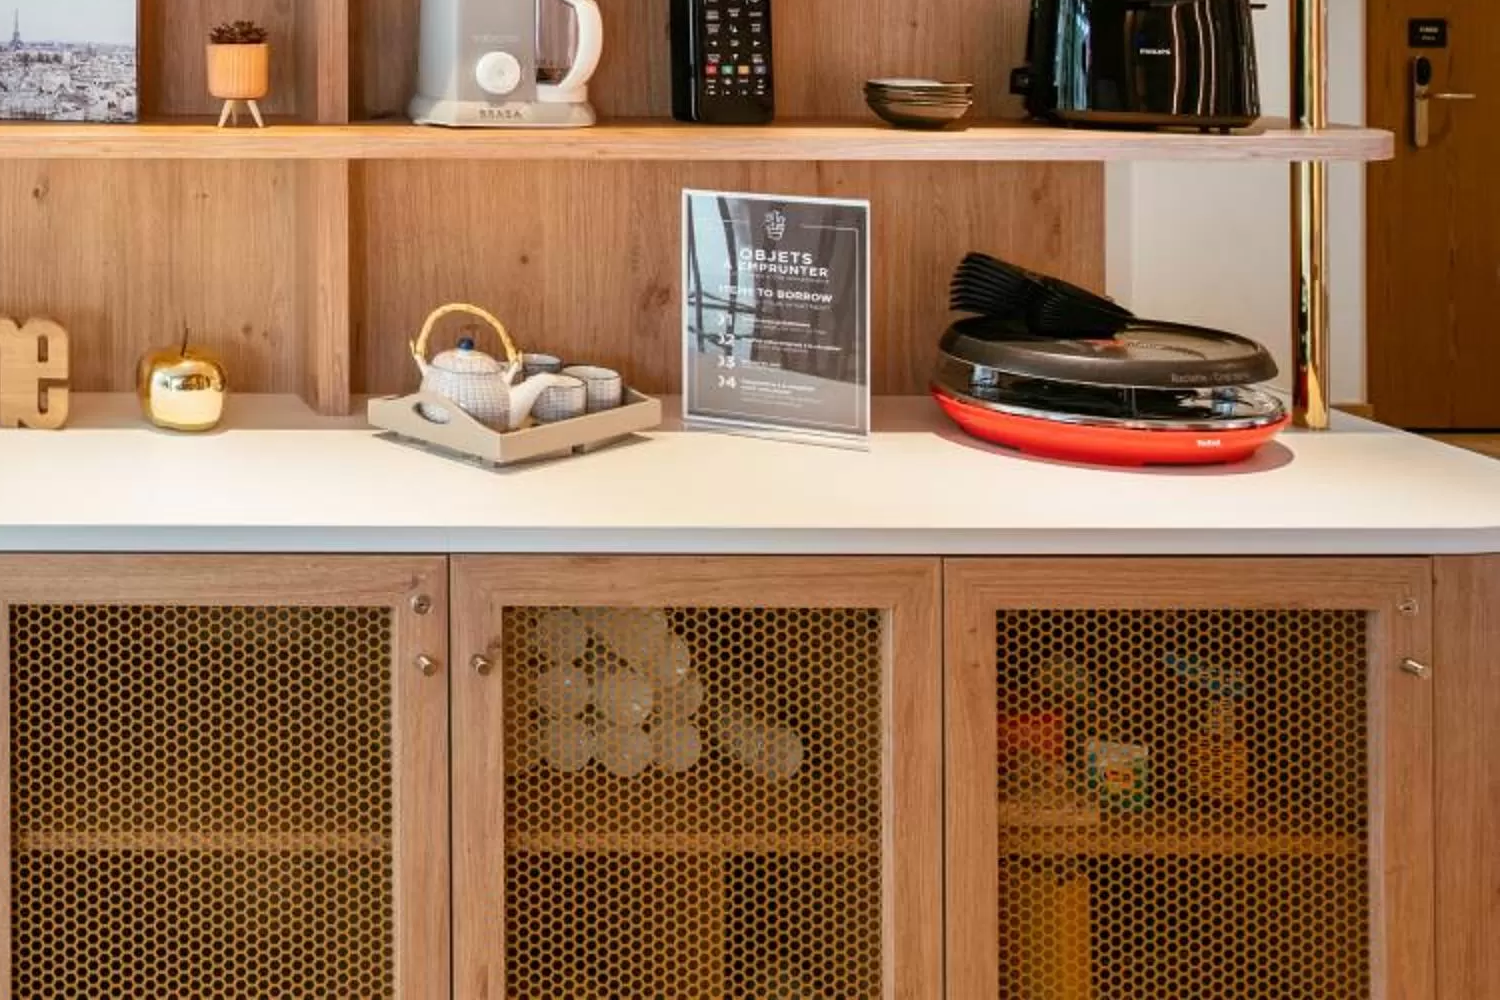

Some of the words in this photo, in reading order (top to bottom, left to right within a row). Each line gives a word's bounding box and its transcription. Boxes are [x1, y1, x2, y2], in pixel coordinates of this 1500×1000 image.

[740, 248, 813, 265] OBJETS
[739, 261, 829, 277] EMPRUNTER
[758, 288, 773, 298] TO
[777, 289, 833, 303] BORROW
